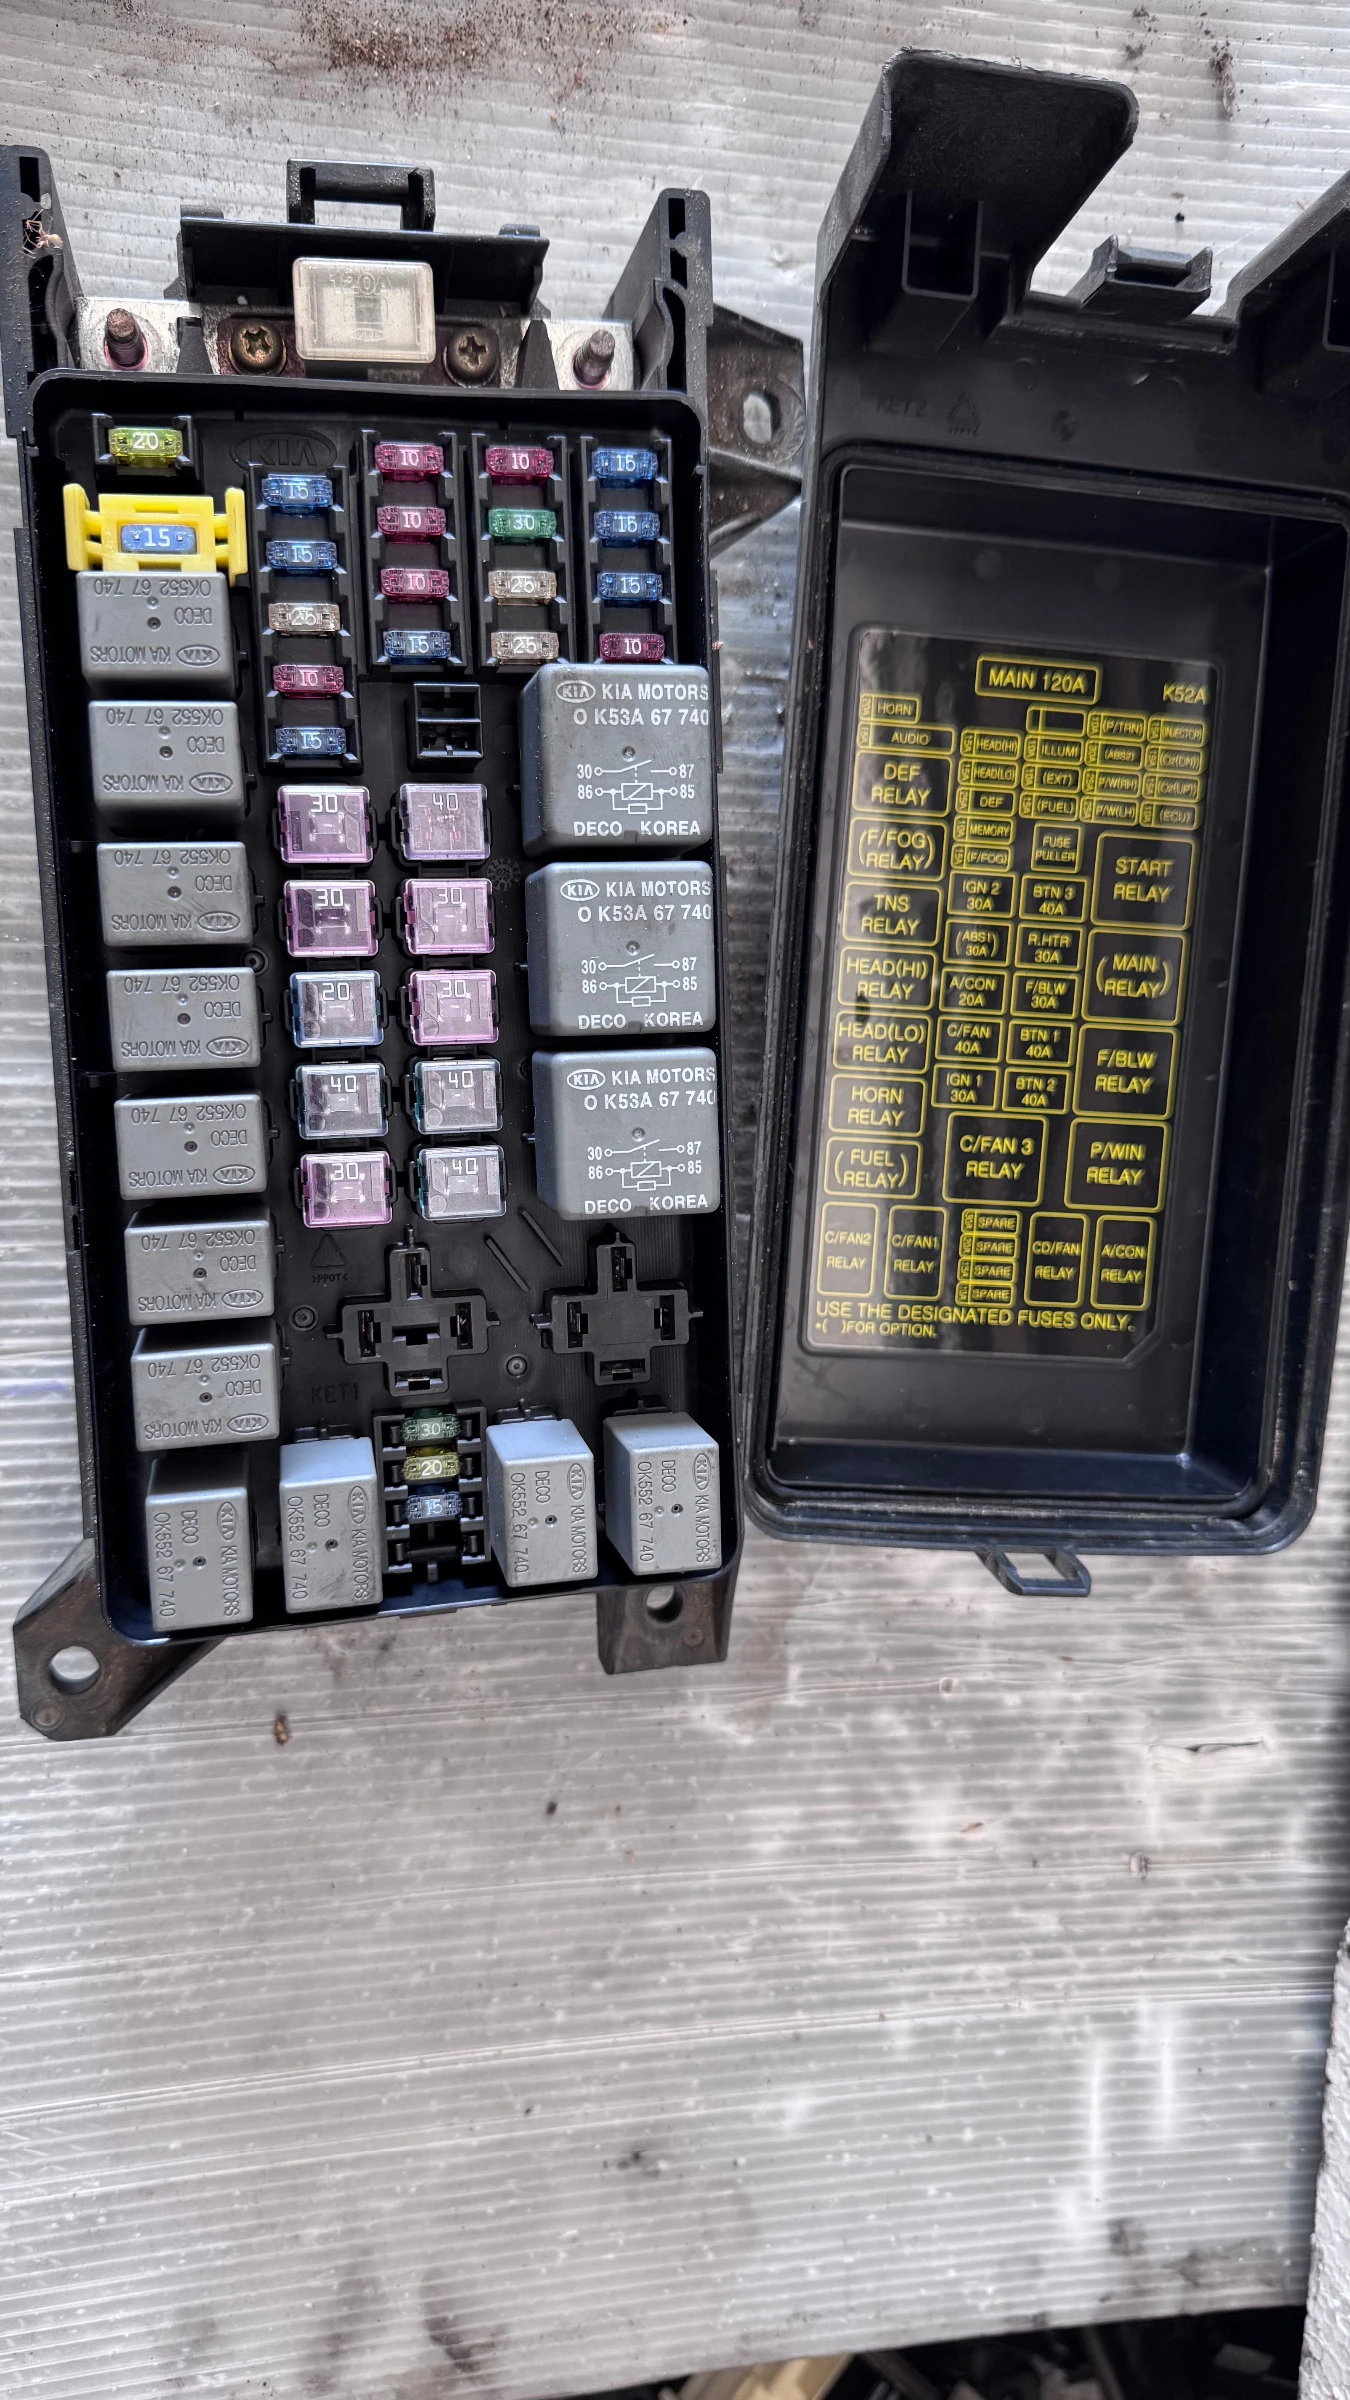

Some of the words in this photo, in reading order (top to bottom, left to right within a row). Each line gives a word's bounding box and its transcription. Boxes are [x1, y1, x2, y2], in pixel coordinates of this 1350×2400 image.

[132, 432, 159, 450] 20
[258, 438, 318, 466] KIA
[400, 450, 420, 466] 10
[512, 453, 530, 470] 10
[616, 454, 636, 472] 15
[288, 481, 310, 500] 15
[402, 512, 422, 528] 10
[513, 514, 535, 531] 30
[616, 516, 637, 532] 15
[144, 527, 171, 548] 15
[291, 545, 312, 562] 15
[94, 579, 123, 597] 740
[132, 579, 151, 597] 67
[407, 574, 426, 590] 10
[510, 576, 534, 593] 25
[620, 577, 640, 594] 15
[174, 607, 212, 626] DECO
[291, 607, 317, 626] 25
[408, 636, 429, 653] 15
[513, 637, 537, 654] 25
[624, 639, 642, 655] 10
[90, 646, 146, 664] MOTORS
[149, 647, 171, 664] KIA
[183, 649, 213, 662] KIA
[300, 669, 318, 687] 10
[989, 667, 1035, 690] MAIN
[1042, 671, 1088, 694] 120A
[562, 685, 590, 698] KIA
[602, 683, 633, 700] KIA
[638, 683, 708, 700] MOTORS
[1163, 684, 1209, 705] K52A
[877, 699, 911, 716] HORN
[595, 708, 644, 726] K53A
[651, 708, 673, 726] 67
[678, 708, 708, 726] 740
[300, 732, 321, 749] 15
[891, 730, 931, 746] AUDIO
[1042, 745, 1078, 758] ILLUMI
[577, 764, 592, 779] 30
[679, 764, 695, 779] 87
[883, 760, 922, 782] DEF
[577, 784, 593, 799] 86
[680, 784, 695, 799] 85
[871, 784, 931, 806] RELAY
[310, 794, 338, 813] 30
[432, 793, 459, 811] 40
[979, 795, 1004, 809] DEF
[574, 821, 622, 837] DECO
[640, 821, 701, 836] KOREA
[970, 821, 1010, 836] MEMORY
[1042, 835, 1073, 849] FUSE
[866, 851, 925, 871] RELAY
[1035, 849, 1076, 862] PULLER
[1115, 857, 1174, 878] START
[437, 887, 463, 905] 30
[567, 884, 594, 897] KIA
[606, 881, 636, 897] KIA
[641, 880, 711, 897] MOTORS
[962, 880, 988, 894] IGN
[990, 882, 1002, 895] 2
[1032, 884, 1061, 899] BTN
[1064, 886, 1076, 900] 3
[1113, 882, 1172, 903] RELAY
[315, 888, 343, 907] 30
[874, 893, 910, 912] TNS
[966, 898, 994, 912] 30A
[598, 905, 648, 922] K53A
[654, 904, 675, 921] 67
[680, 904, 712, 920] 740
[1039, 902, 1065, 916] 40A
[861, 916, 921, 936] RELAY
[1034, 950, 1061, 964] 30A
[846, 958, 929, 979] HEAD(HI)
[322, 982, 350, 1001] 20
[440, 980, 467, 998] 30
[856, 982, 915, 1002] RELAY
[949, 977, 996, 993] A/CON
[1025, 980, 1065, 996] F/BLW
[958, 993, 984, 1007] 20A
[1031, 995, 1058, 1010] 30A
[578, 1014, 626, 1030] DECO
[644, 1011, 704, 1027] KOREA
[838, 1022, 924, 1044] HEAD(LO)
[947, 1024, 991, 1039] C/FAN
[1020, 1029, 1047, 1043] BTN
[1052, 1031, 1060, 1043] 1
[852, 1045, 909, 1065] RELAY
[954, 1041, 980, 1055] 40A
[1025, 1044, 1052, 1059] 40A
[1097, 1050, 1156, 1070] F/BLW
[330, 1075, 357, 1093] 40
[448, 1070, 474, 1088] 40
[946, 1073, 972, 1087] IGN
[976, 1074, 983, 1087] 1
[1015, 1077, 1044, 1092] BTN
[1046, 1079, 1057, 1092] 2
[1095, 1075, 1153, 1095] RELAY
[852, 1085, 903, 1105] HORN
[950, 1089, 976, 1103] 30A
[1021, 1093, 1047, 1108] 40A
[848, 1106, 904, 1127] RELAY
[960, 1135, 1017, 1155] C/FAN
[1021, 1138, 1034, 1156] 3
[1091, 1142, 1145, 1162] P/WIN
[331, 1162, 359, 1180] 30
[452, 1157, 477, 1175] 40
[966, 1160, 1024, 1181] RELAY
[843, 1171, 900, 1189] RELAY
[1086, 1166, 1144, 1186] RELAY
[978, 1216, 1016, 1230] SPARE
[825, 1231, 872, 1246] C/FAN2
[892, 1234, 938, 1249] C/FAN1
[976, 1241, 1014, 1255] SPARE
[1032, 1240, 1081, 1257] CD/FAN
[1101, 1244, 1145, 1259] A/CON
[827, 1255, 865, 1270] RELAY
[894, 1259, 934, 1274] RELAY
[1035, 1266, 1075, 1281] RELAY
[1101, 1269, 1143, 1284] RELAY
[817, 1302, 855, 1318] USE
[859, 1304, 893, 1320] THE
[898, 1305, 1011, 1327] DESIGNATED
[1017, 1310, 1076, 1329] FUSES
[311, 1384, 359, 1404] KET1
[421, 1422, 441, 1437] 30
[421, 1461, 443, 1475] 20
[426, 1501, 443, 1515] 15
[181, 1510, 199, 1544] DECO
[221, 1546, 237, 1568] KIA
[157, 1567, 174, 1585] 67
[221, 1568, 240, 1617] MOTORS
[158, 1591, 176, 1617] 740
